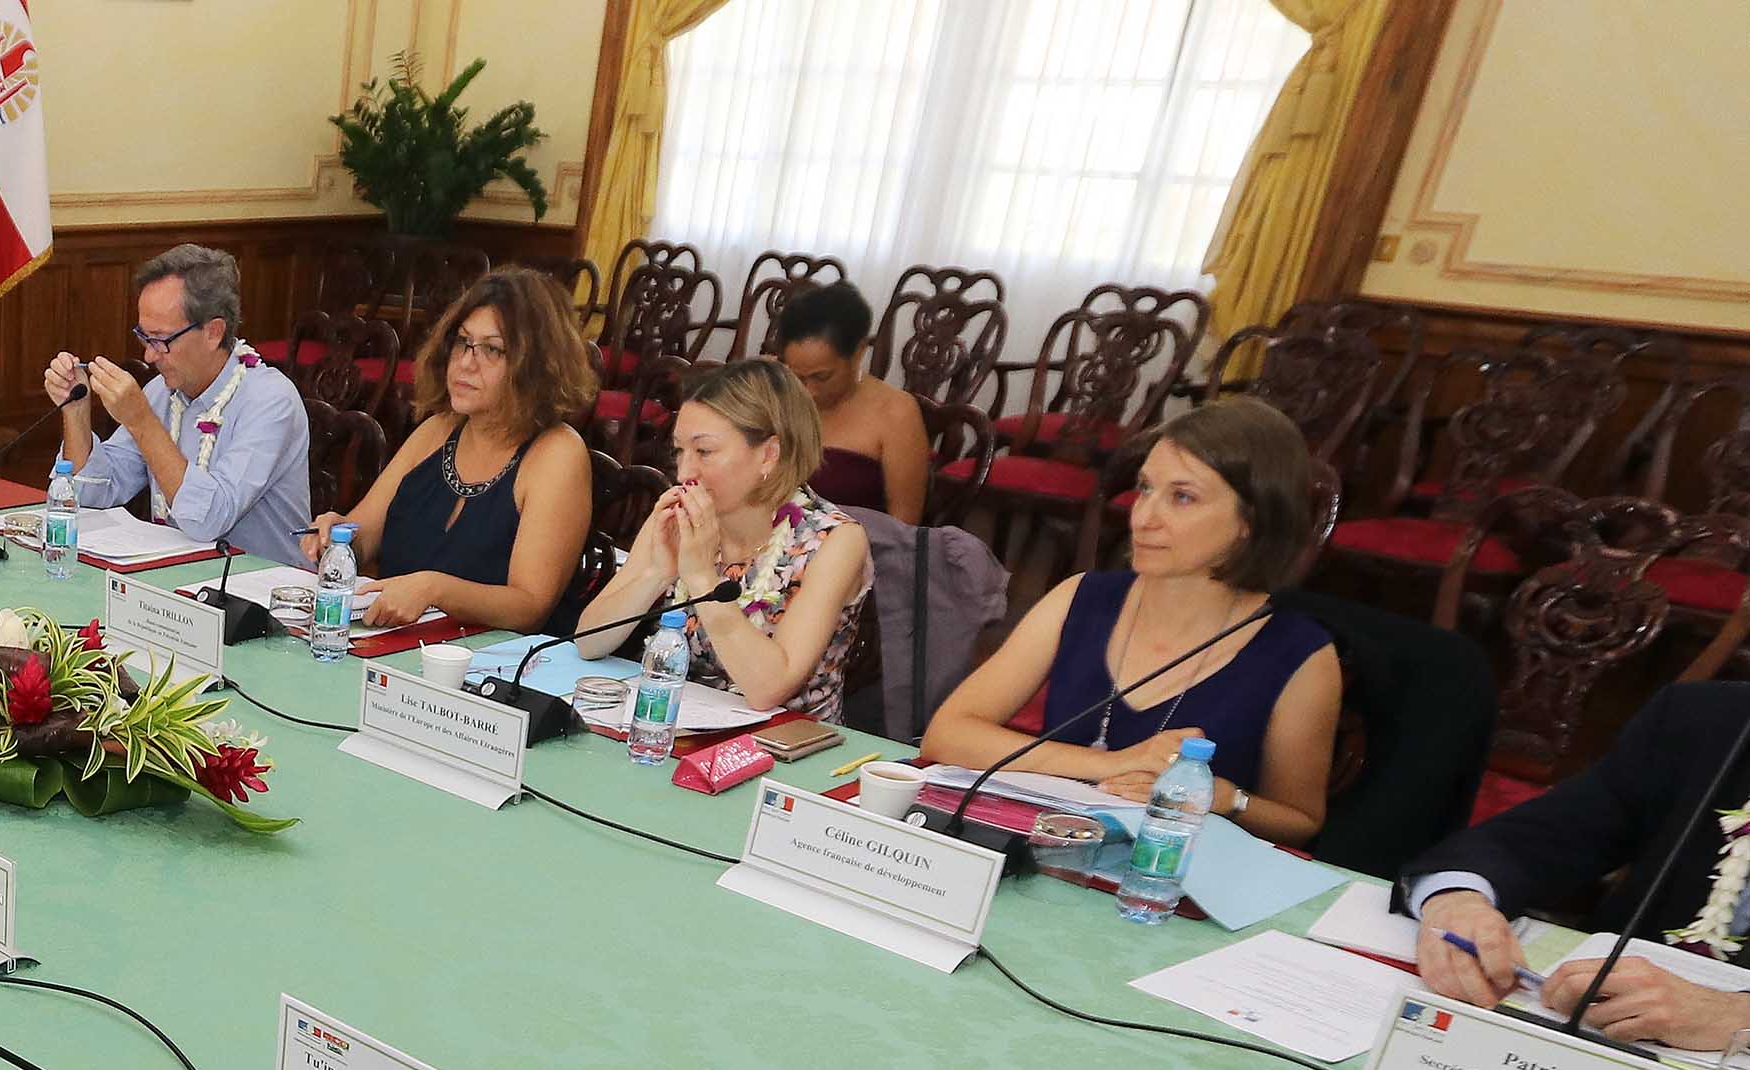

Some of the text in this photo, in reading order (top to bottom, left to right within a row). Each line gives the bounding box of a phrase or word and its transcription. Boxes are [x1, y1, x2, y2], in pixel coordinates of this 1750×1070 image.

[161, 608, 193, 626] TRILLON
[400, 693, 498, 735] Lise TALBOT-BARRÉ
[790, 837, 946, 896] Agence française de développement
[824, 826, 931, 869] Céline GILQUIN
